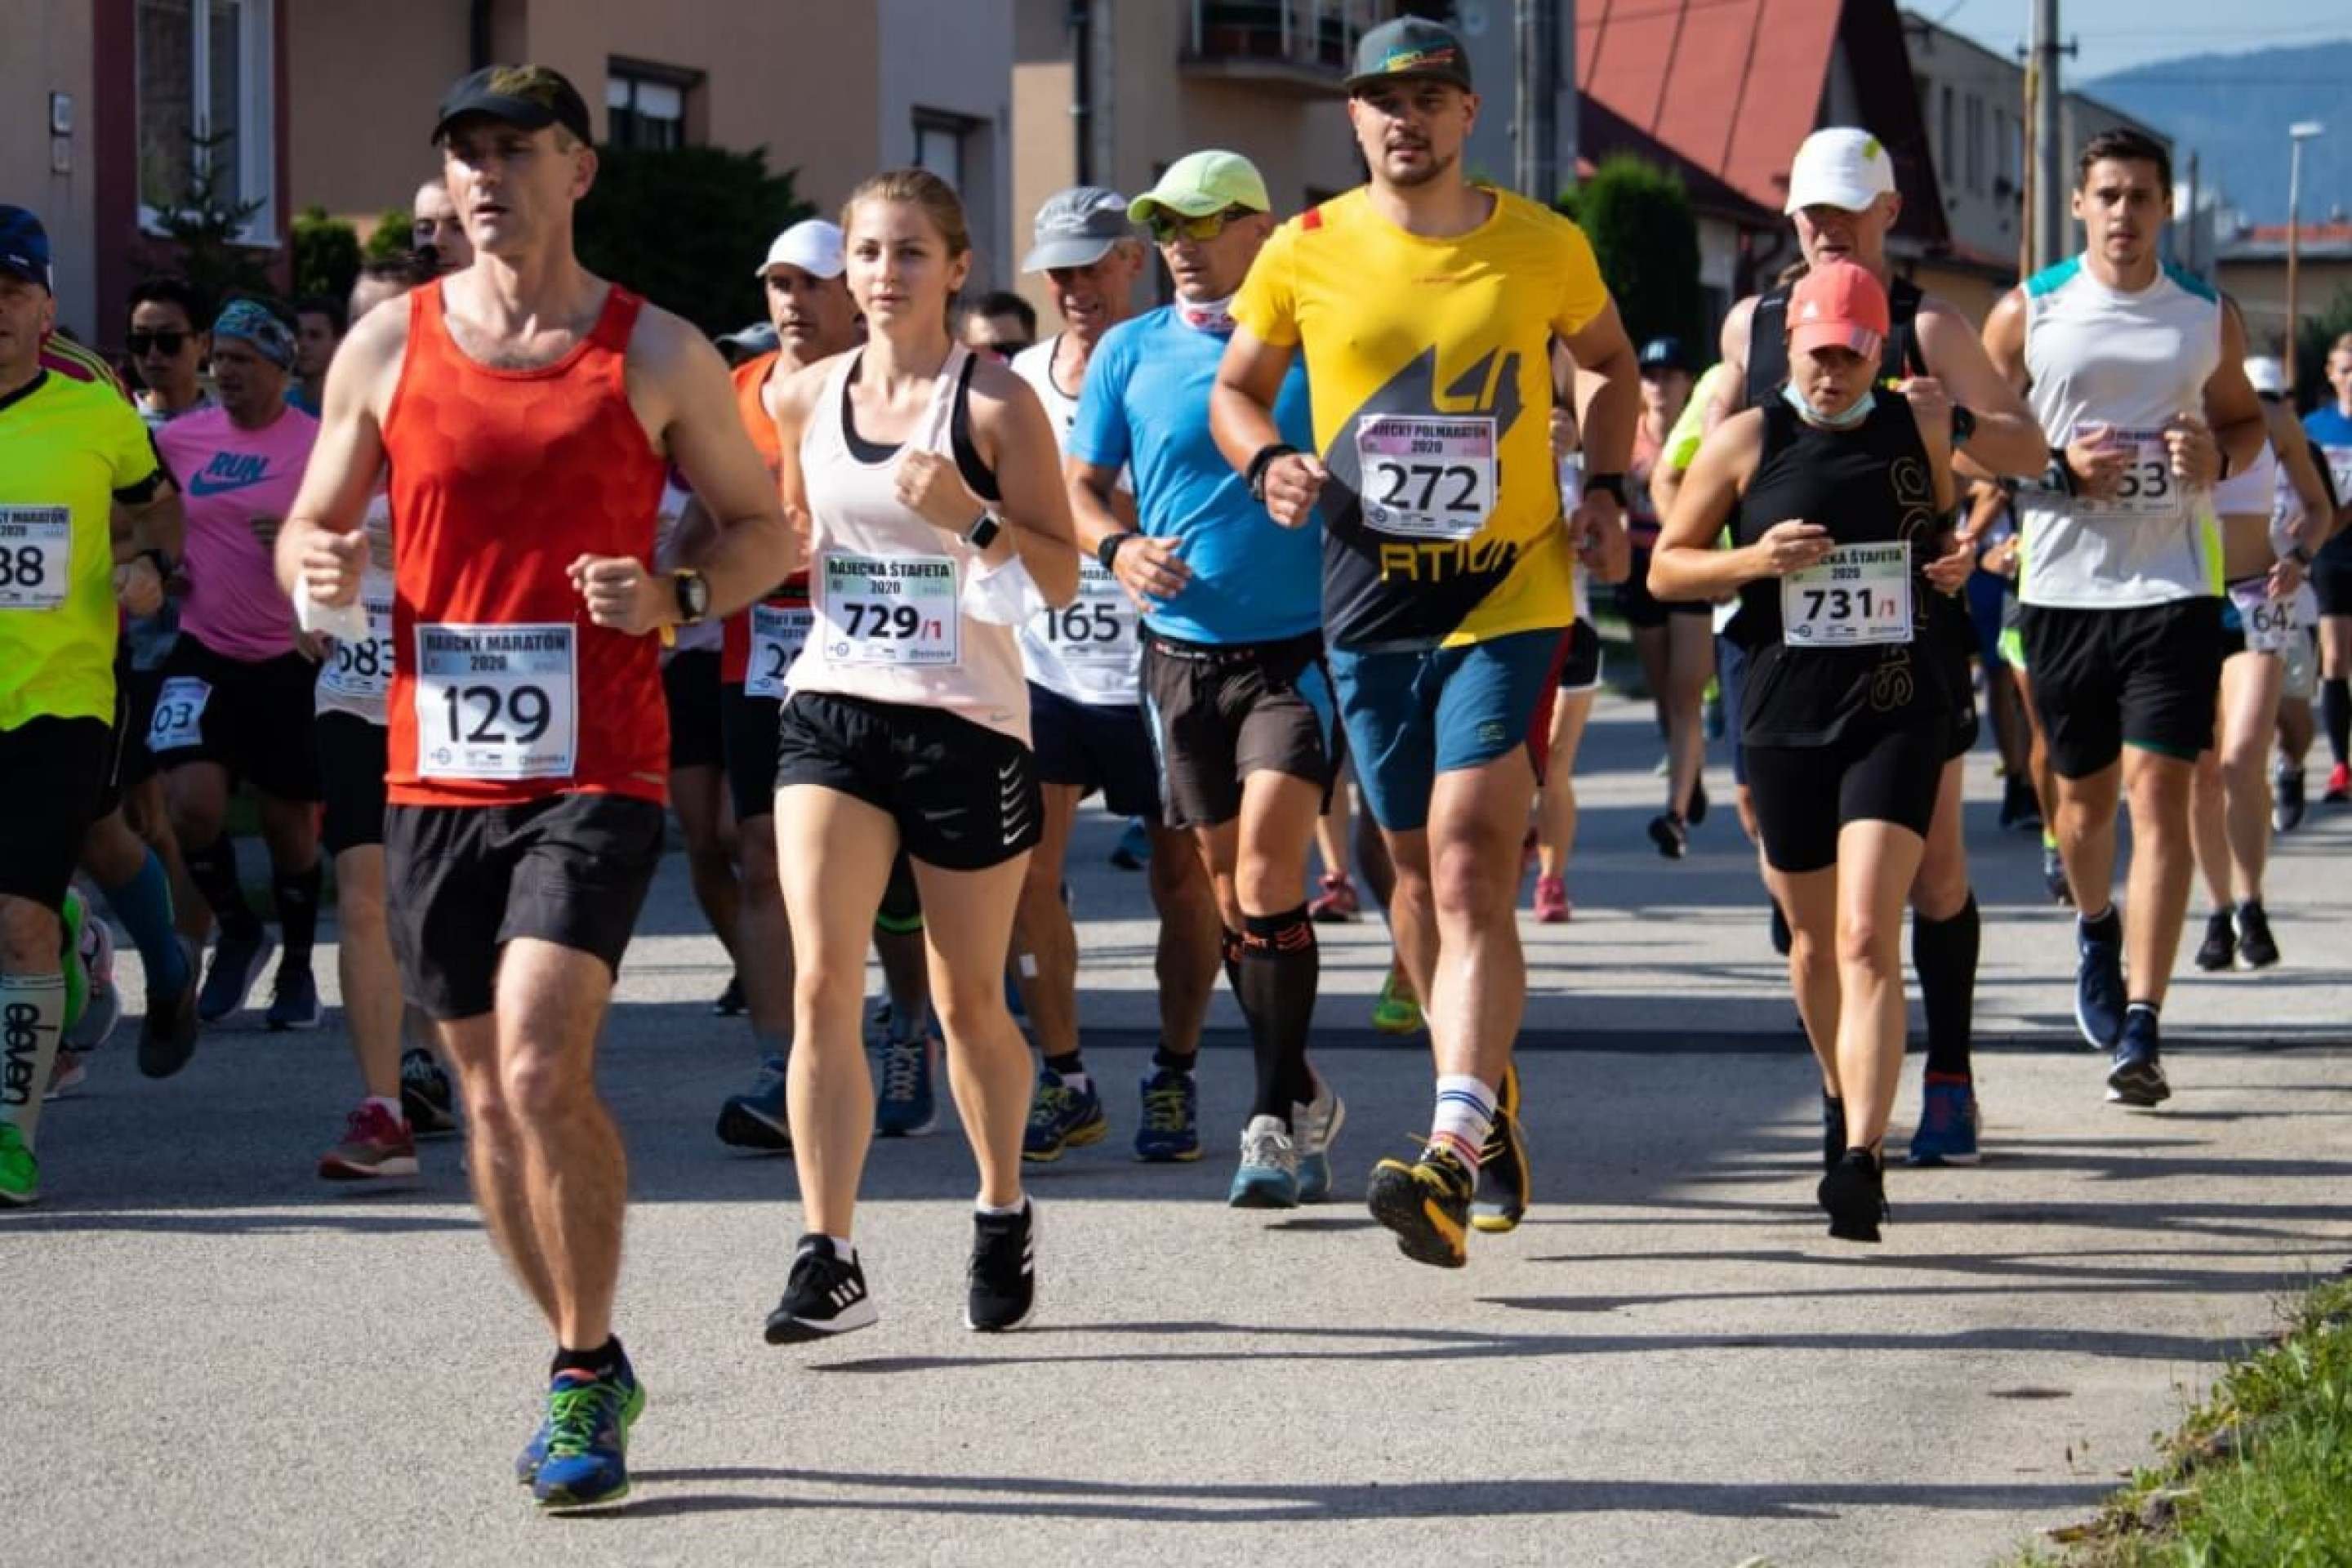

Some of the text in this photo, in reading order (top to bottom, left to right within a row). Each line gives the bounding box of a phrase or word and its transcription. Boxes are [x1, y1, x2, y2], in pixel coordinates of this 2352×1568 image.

[1411, 440, 1443, 453] 2020
[207, 452, 270, 482] RUN
[1377, 463, 1481, 511] 272
[871, 580, 901, 594] 2020
[1832, 568, 1861, 580] 2020
[843, 603, 942, 640] 729/1
[1045, 603, 1120, 642] 165
[470, 655, 507, 672] 2020
[443, 684, 551, 745] 129
